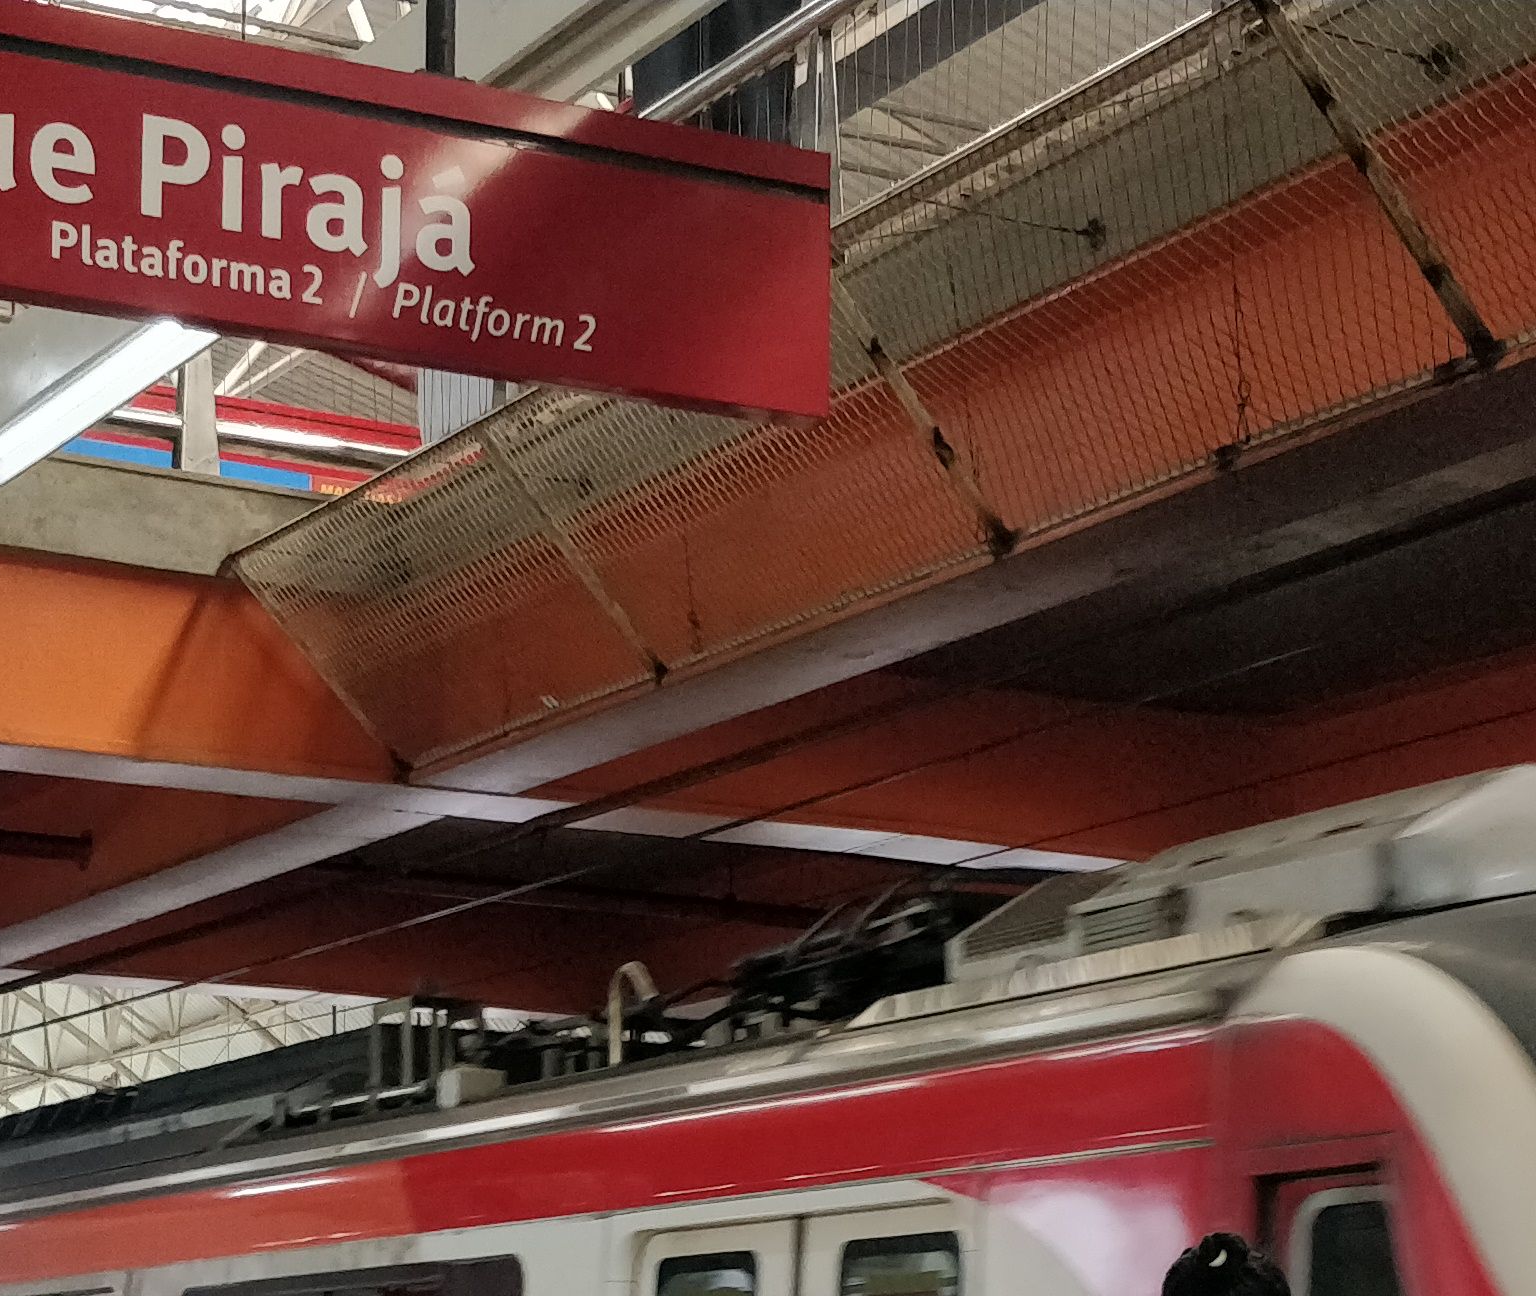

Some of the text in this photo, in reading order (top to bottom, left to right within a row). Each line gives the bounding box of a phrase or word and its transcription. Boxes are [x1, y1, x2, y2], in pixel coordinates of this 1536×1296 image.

[140, 113, 476, 288] Pirajá
[51, 220, 292, 302] Plataforma
[301, 264, 324, 305] 2
[392, 281, 566, 347] Platform
[573, 313, 598, 352] 2
